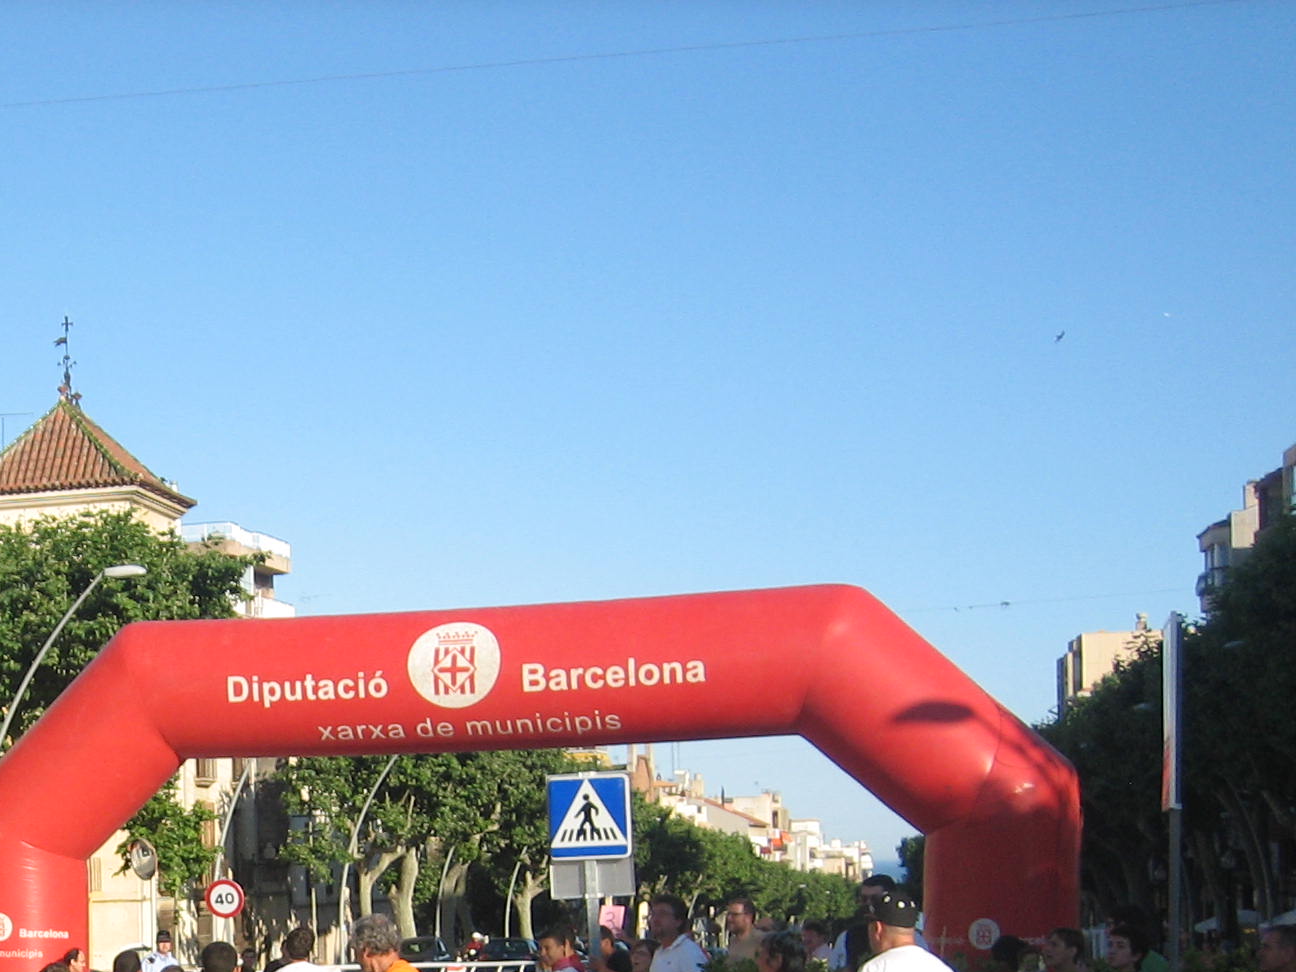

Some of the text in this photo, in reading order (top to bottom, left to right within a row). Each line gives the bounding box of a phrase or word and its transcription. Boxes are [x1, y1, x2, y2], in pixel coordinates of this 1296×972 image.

[227, 657, 707, 708] Diputació Barcelona
[318, 709, 623, 741] xarxa de municipis
[215, 892, 235, 905] 40
[18, 927, 70, 940] Barcelona
